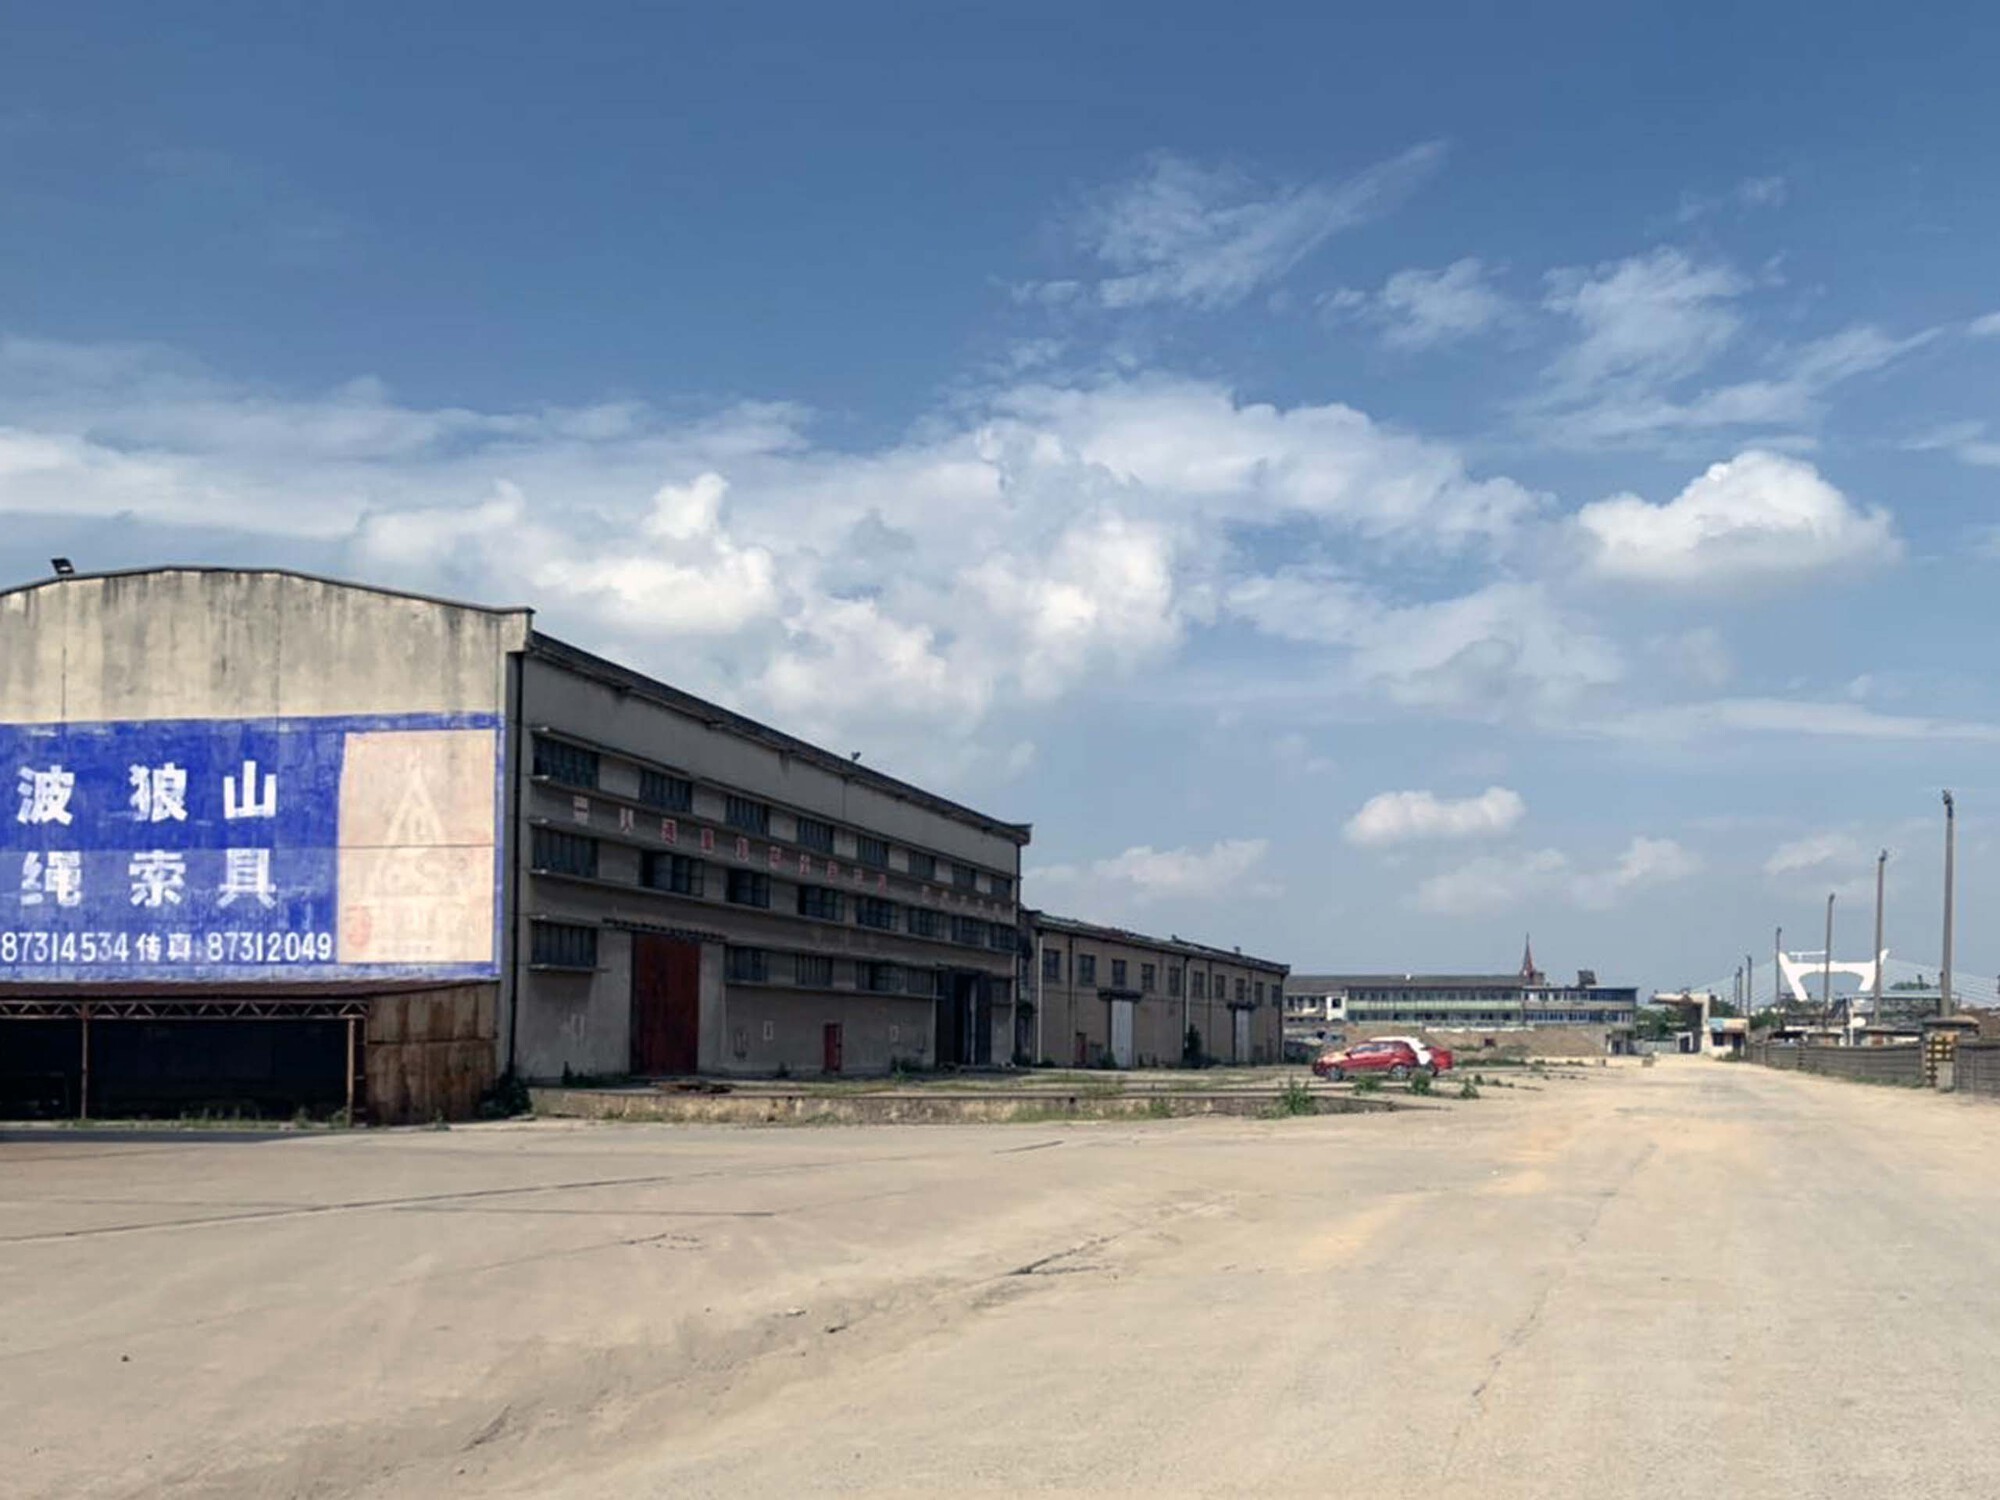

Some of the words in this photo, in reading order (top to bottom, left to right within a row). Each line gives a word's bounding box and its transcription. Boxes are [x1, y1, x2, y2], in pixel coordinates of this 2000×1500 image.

[17, 760, 277, 825] 波狼山
[20, 848, 276, 908] 绳索具
